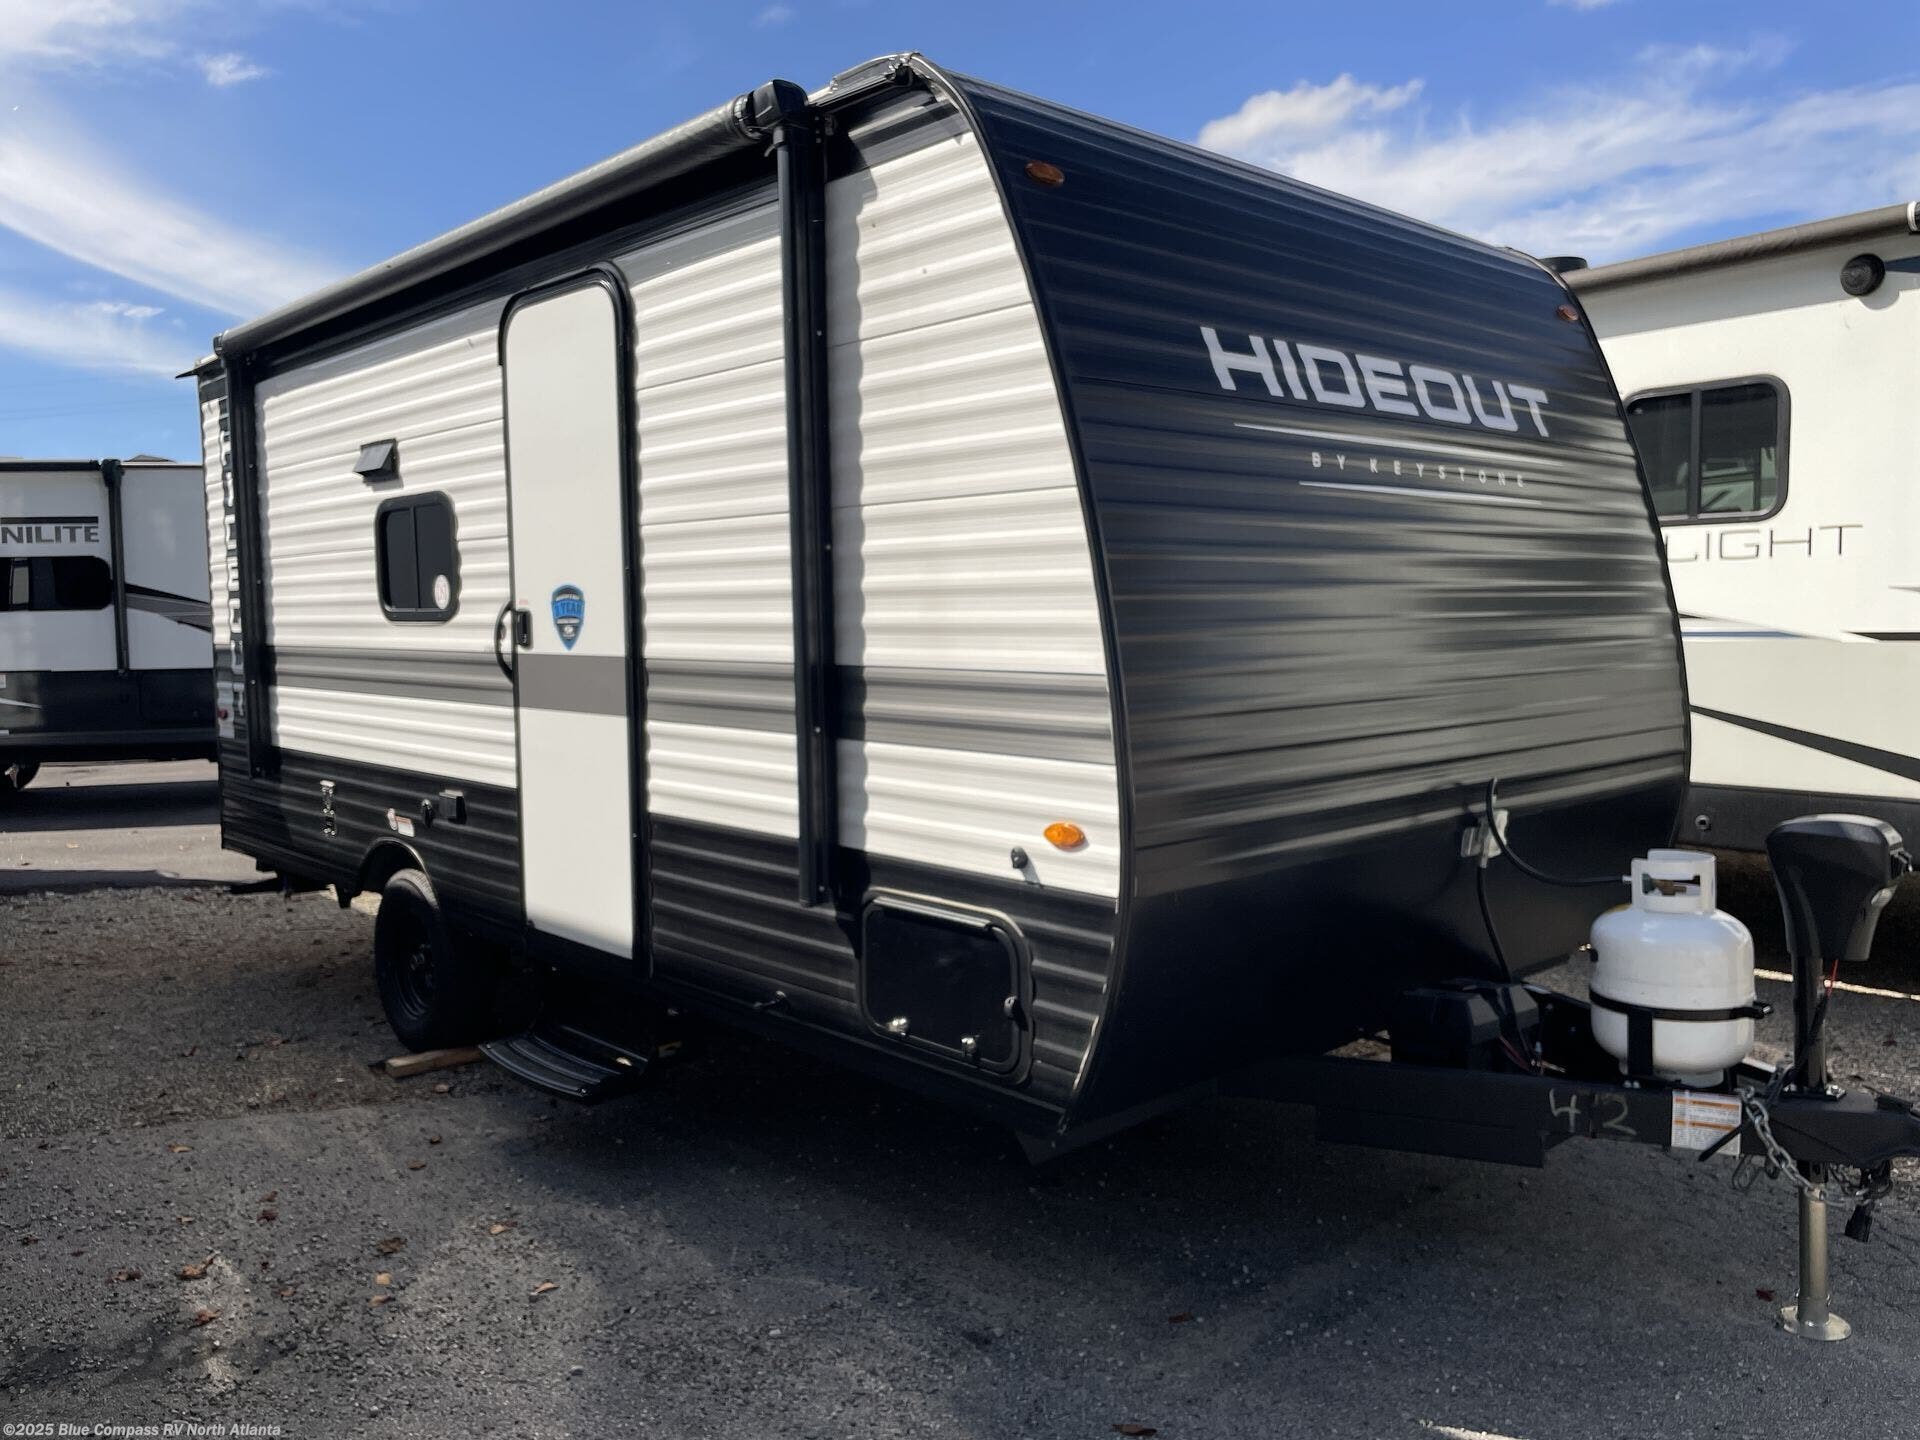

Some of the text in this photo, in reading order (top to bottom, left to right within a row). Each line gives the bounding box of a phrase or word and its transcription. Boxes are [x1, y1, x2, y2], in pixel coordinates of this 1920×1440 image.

[1200, 326, 1550, 438] HIDEOUT
[1311, 451, 1524, 488] BY KEYSTONE
[0, 525, 99, 544] NILITE
[1664, 523, 1863, 563] LIGHT
